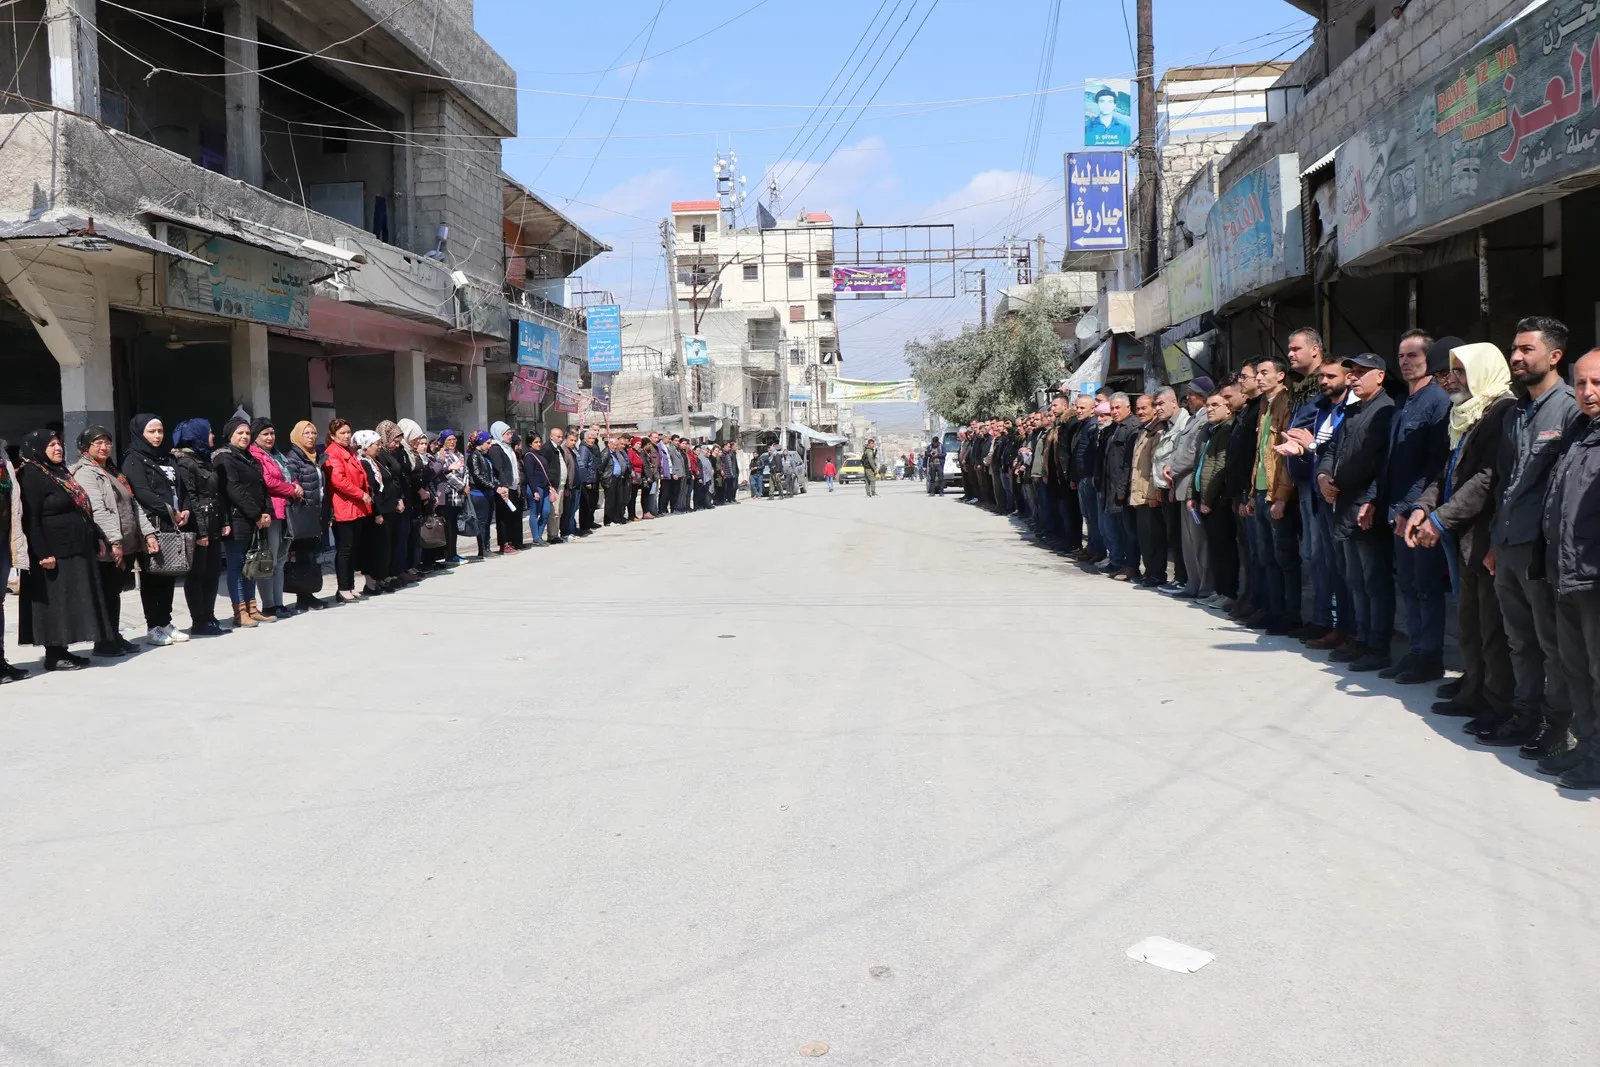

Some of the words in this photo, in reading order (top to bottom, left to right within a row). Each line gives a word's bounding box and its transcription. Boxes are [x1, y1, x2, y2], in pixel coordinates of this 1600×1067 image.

[1495, 43, 1517, 72] YA
[1070, 158, 1121, 194] صيدلية
[1520, 140, 1553, 179] مفرق
